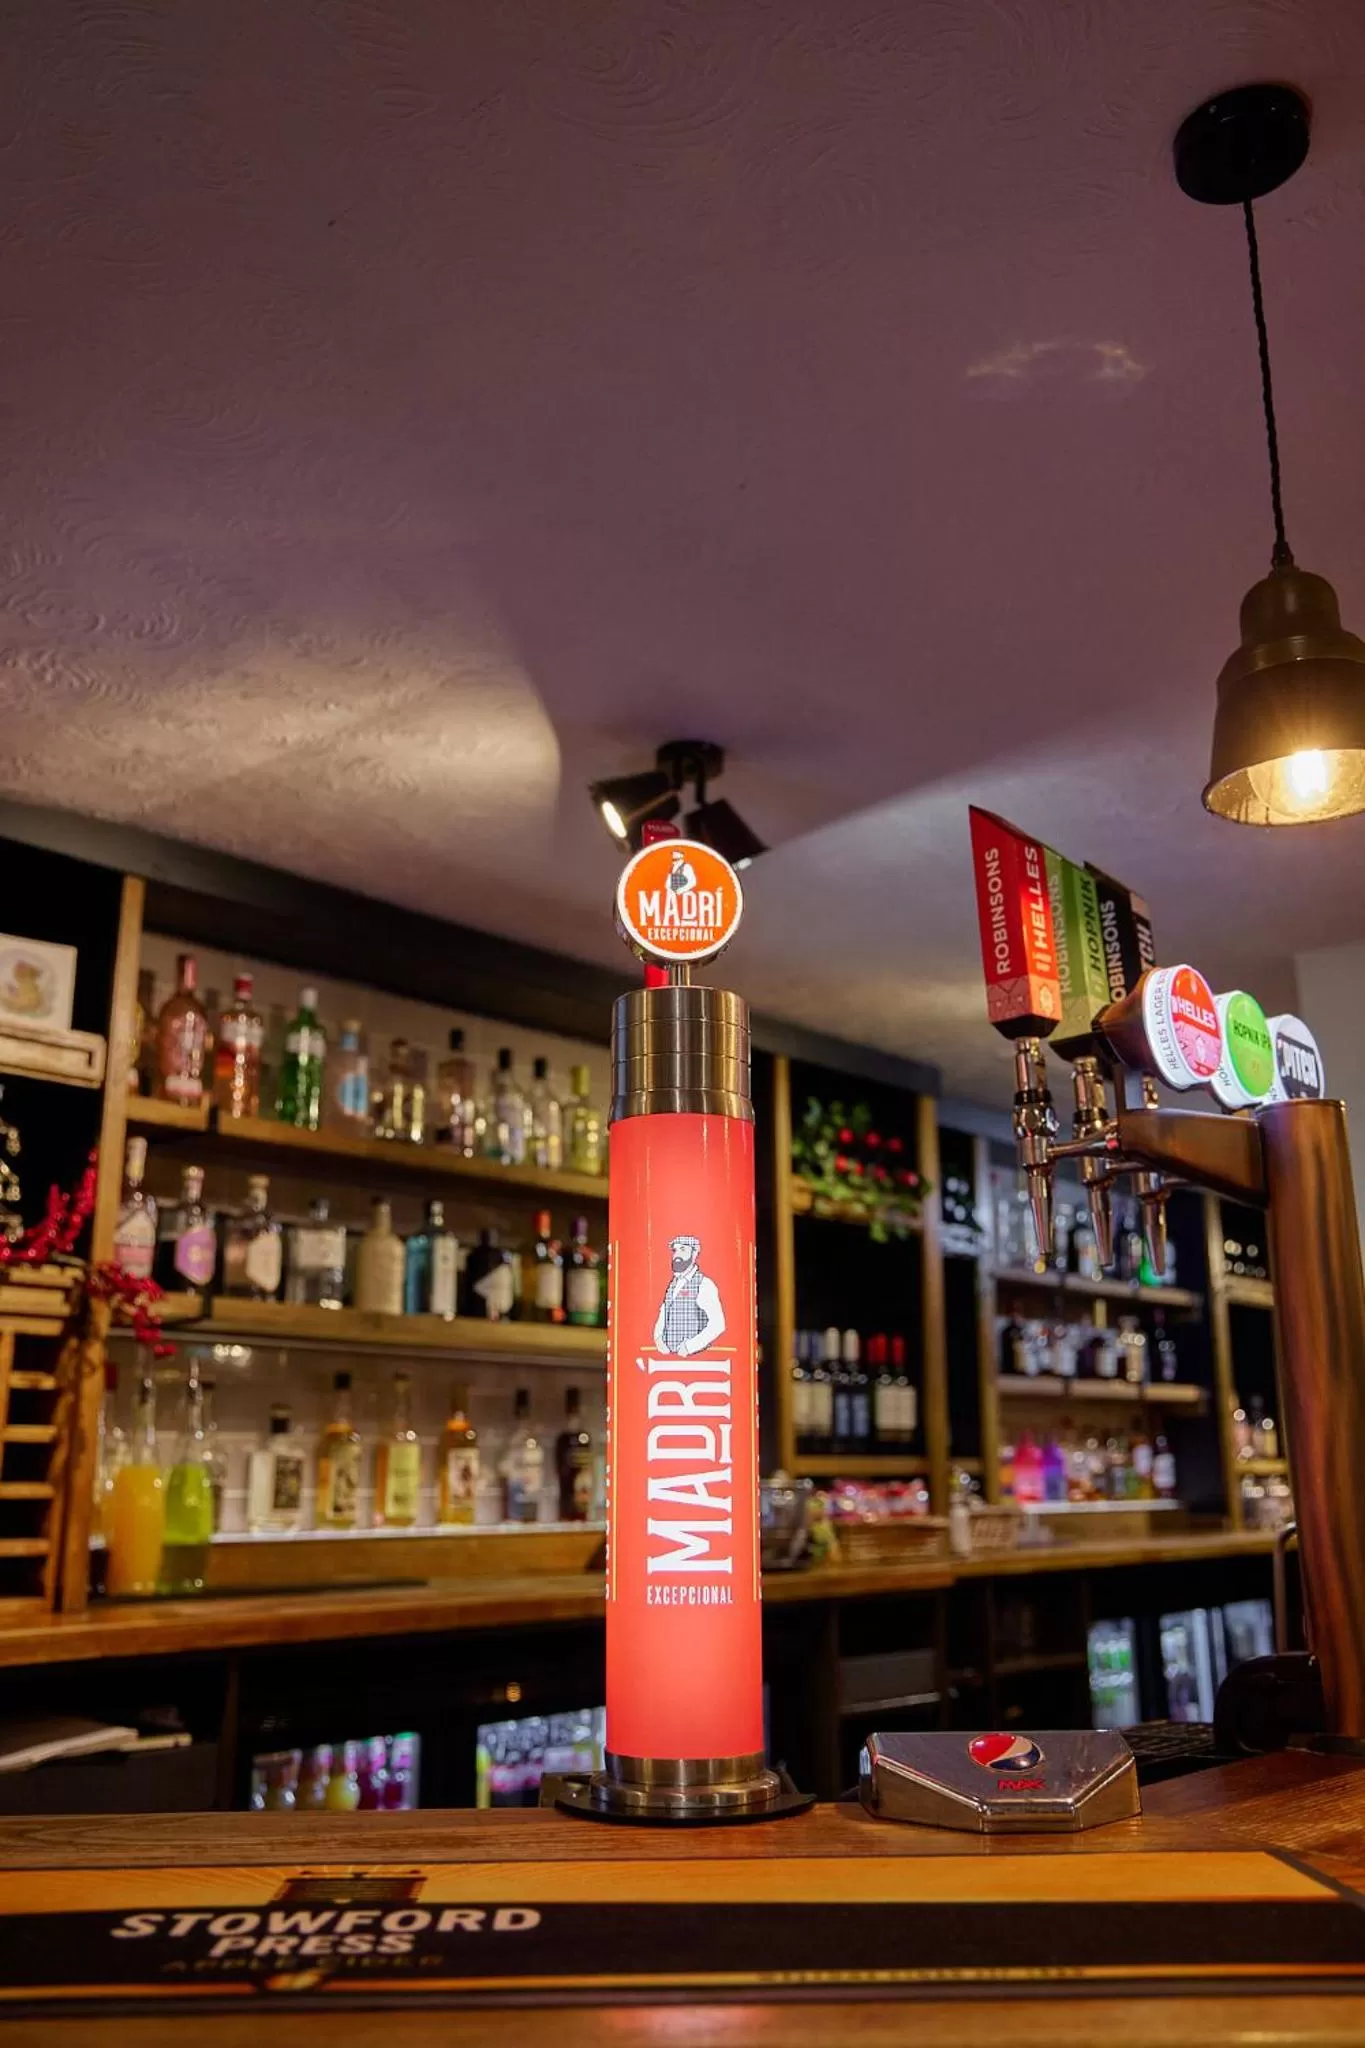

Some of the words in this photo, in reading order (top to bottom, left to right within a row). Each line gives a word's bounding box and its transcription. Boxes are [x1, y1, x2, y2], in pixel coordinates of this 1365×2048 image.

[637, 886, 724, 928] MADRÍ
[647, 927, 715, 942] EXCEPCIONAL
[985, 846, 1011, 975] ROBINSONS
[1024, 845, 1049, 949] HELLES
[1048, 875, 1073, 994] ROBINSONS
[1080, 876, 1102, 972] HOPNIK
[1100, 900, 1127, 1004] OBINSONS
[636, 1356, 733, 1575] MADRÍ
[646, 1584, 733, 1605] EXCEPCIONAL
[110, 1907, 543, 1940] STOWFORD
[208, 1932, 417, 1959] PRESS
